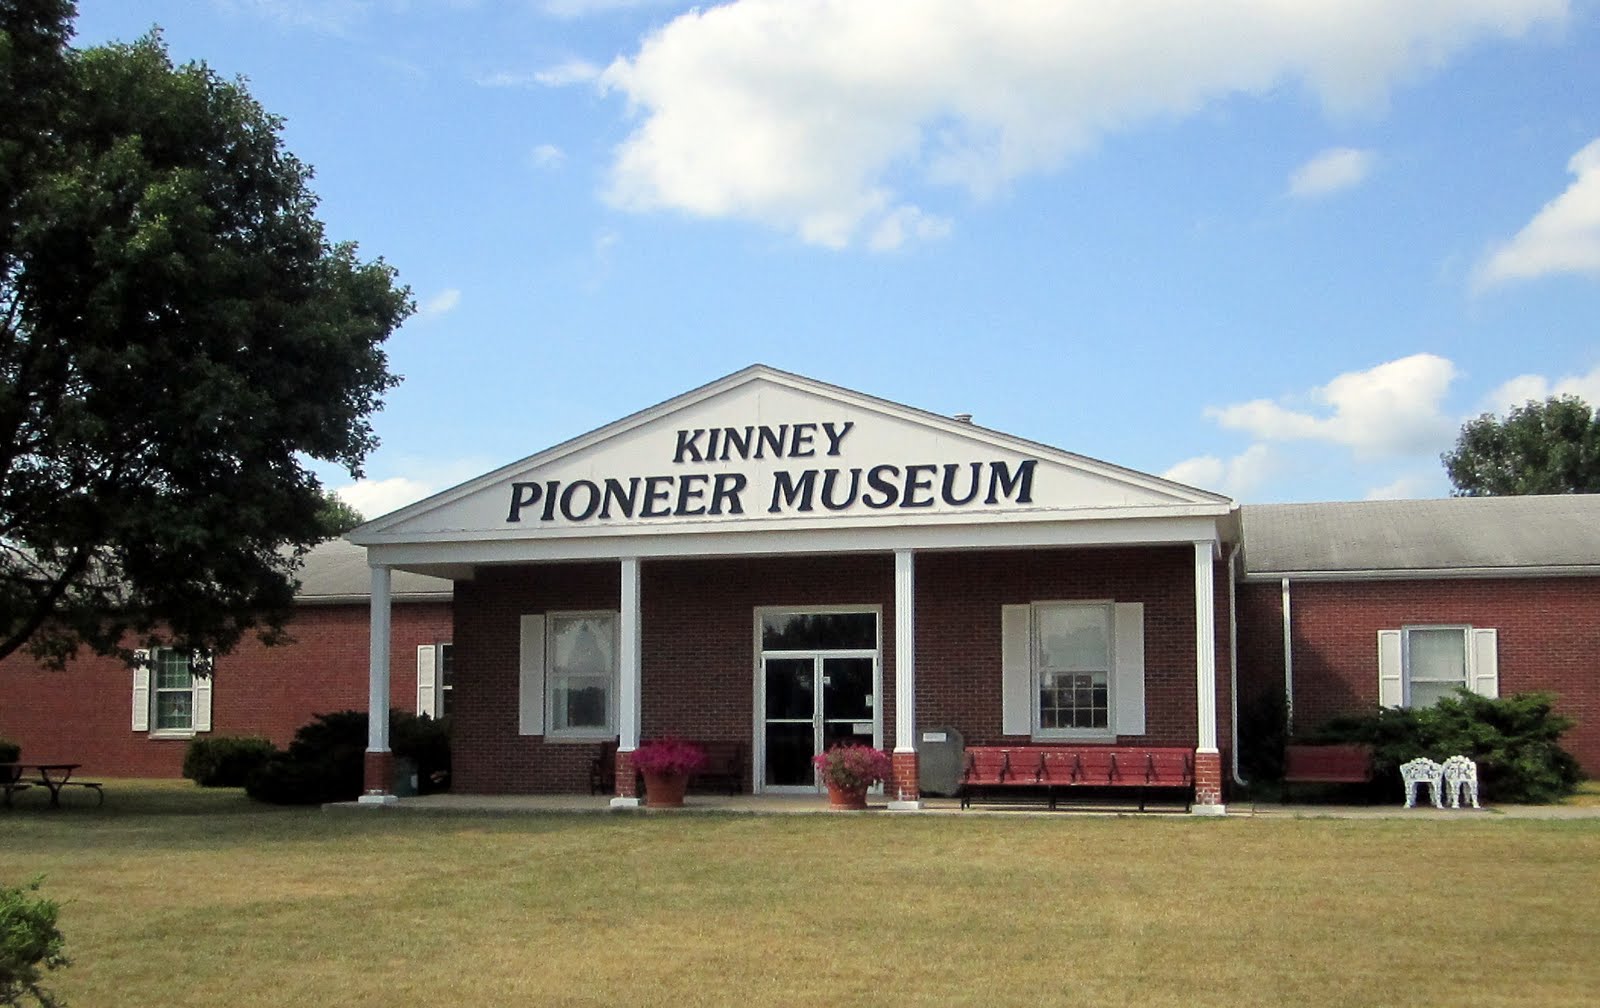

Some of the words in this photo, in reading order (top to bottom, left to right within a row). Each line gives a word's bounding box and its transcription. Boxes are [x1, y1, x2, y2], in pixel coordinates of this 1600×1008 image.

[673, 422, 854, 463] KINNEY
[506, 473, 747, 523] PIONEER
[768, 460, 1038, 513] MUSEUM
